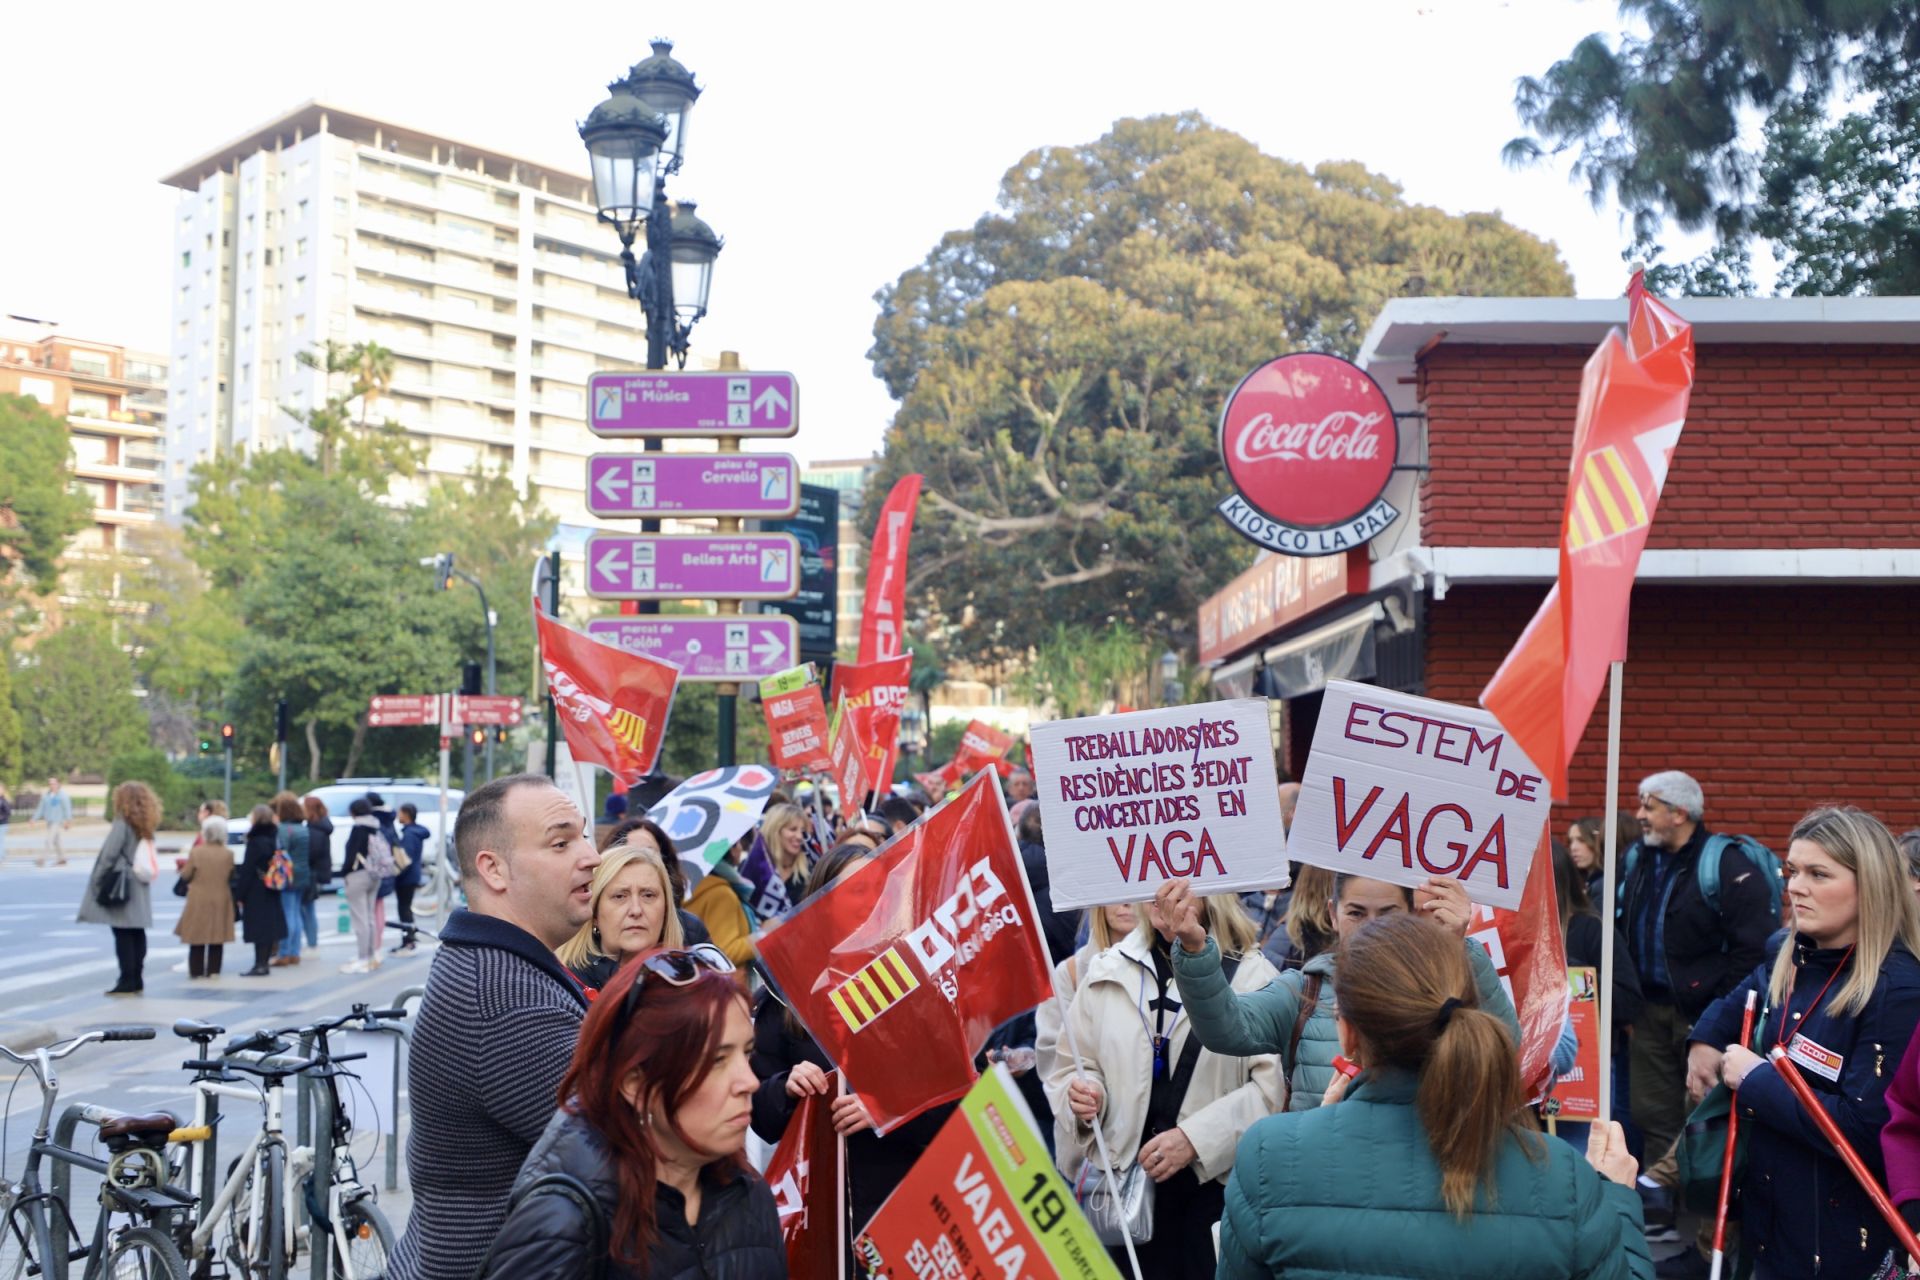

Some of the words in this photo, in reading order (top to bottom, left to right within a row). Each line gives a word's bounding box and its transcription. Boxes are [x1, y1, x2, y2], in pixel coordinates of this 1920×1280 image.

[624, 379, 654, 389] palau
[655, 379, 669, 388] de
[625, 390, 637, 402] la
[642, 389, 690, 402] Música
[1235, 411, 1386, 462] Coca-Cola
[702, 470, 758, 483] Cervelló
[714, 460, 743, 470] palau
[744, 459, 758, 469] de
[1226, 500, 1309, 550] KIOSCO
[1319, 531, 1348, 550] LA
[1353, 503, 1394, 540] PAZ
[682, 553, 724, 565] Belles
[728, 553, 758, 565] Arts
[744, 542, 758, 551] de
[621, 635, 662, 648] Colón
[660, 624, 674, 633] de
[1344, 702, 1504, 771] ESTEM
[1495, 769, 1542, 802] DE
[1074, 795, 1201, 831] CONCERTADES
[1217, 789, 1247, 817] EN
[1332, 776, 1509, 889] VAGA
[1106, 826, 1228, 883] VAGA
[929, 1194, 951, 1225] NO
[953, 1152, 1026, 1280] VAGA
[1022, 1172, 1065, 1233] 19
[1058, 1227, 1098, 1280] FEBRE
[931, 1233, 969, 1280] SE
